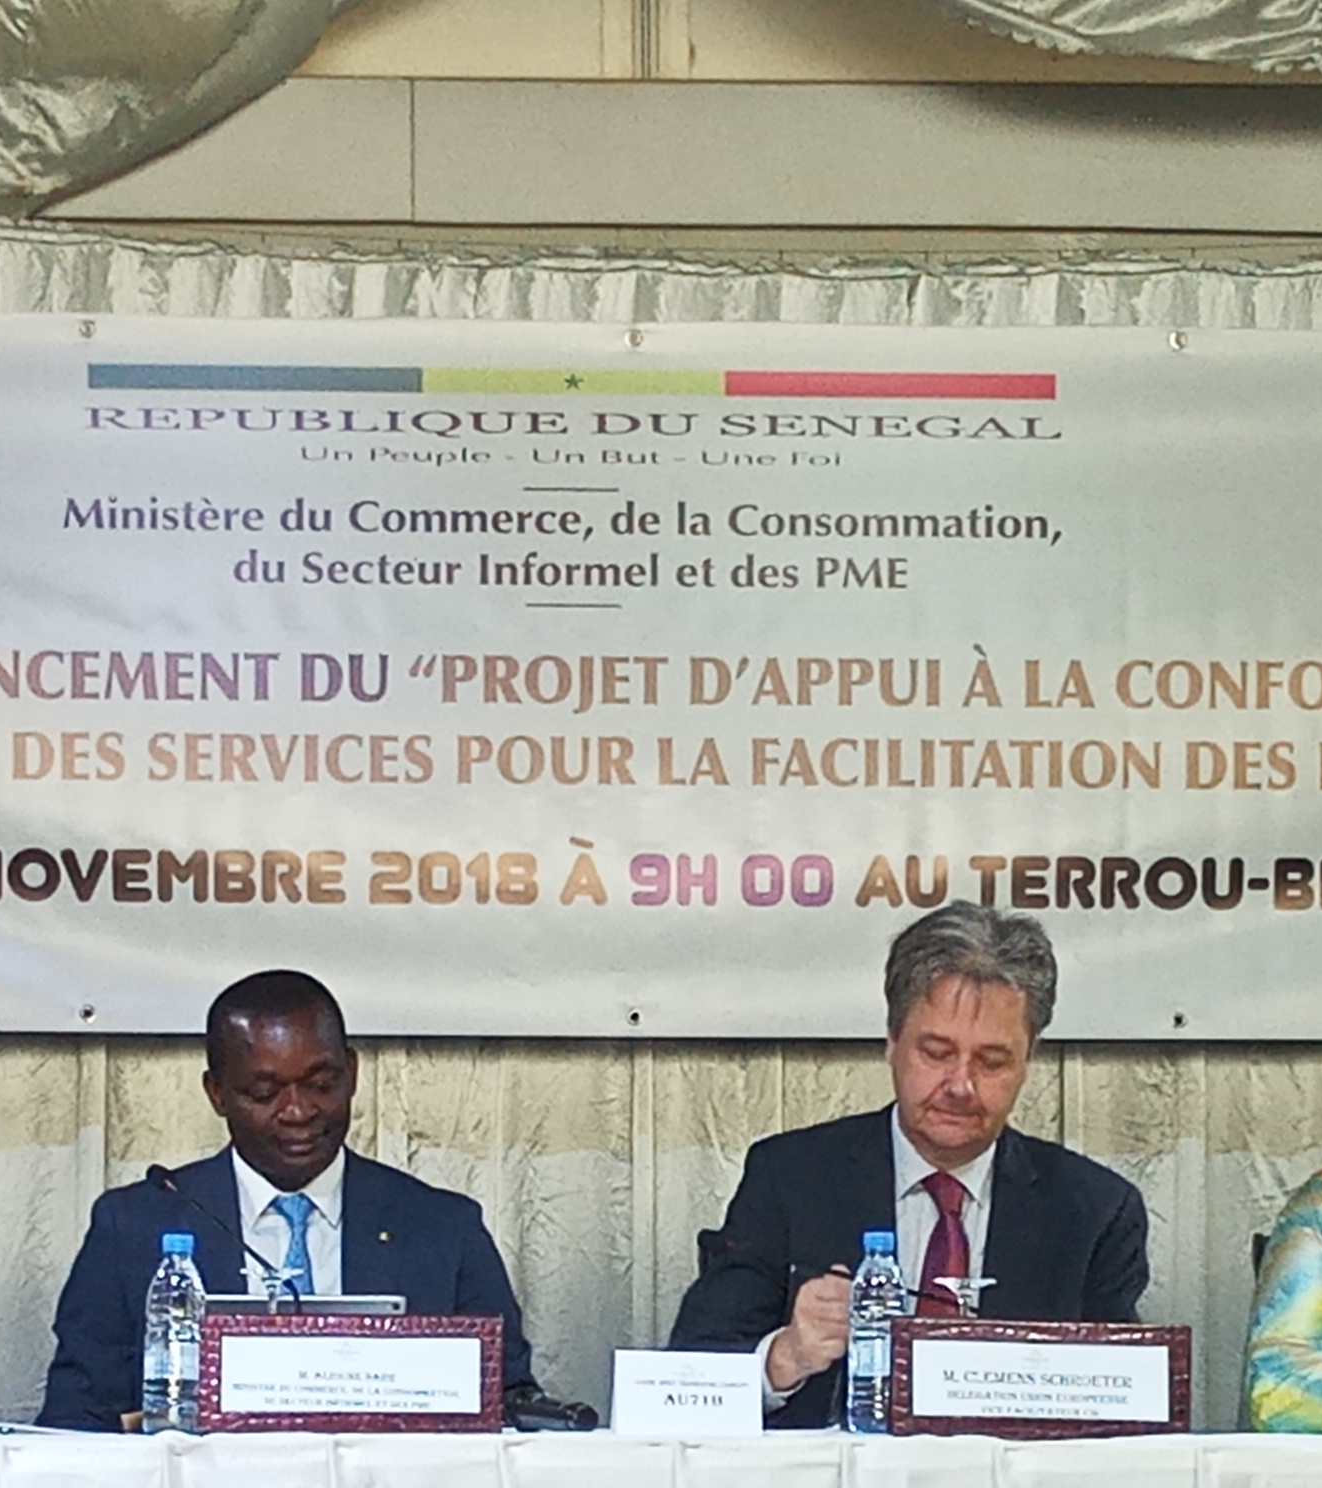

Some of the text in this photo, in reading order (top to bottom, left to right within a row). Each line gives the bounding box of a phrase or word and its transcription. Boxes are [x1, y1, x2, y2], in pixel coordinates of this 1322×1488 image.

[84, 408, 1062, 440] REPUBLIQUE DU SENEGAL
[303, 449, 353, 461] Un
[372, 449, 491, 467] Peuple
[534, 450, 585, 464] Un
[603, 452, 657, 464] But
[703, 452, 777, 466] Une
[793, 454, 840, 466] Foi
[62, 497, 1062, 546] Ministère du Commerce, de la Consommation,
[235, 550, 908, 589] du Secteur Informel et des PME
[303, 655, 389, 703] DU
[964, 645, 1003, 708] À
[1026, 661, 1096, 709] LA
[14, 733, 125, 781] DES
[150, 734, 434, 784] SERVICES
[459, 736, 636, 785] POUR
[658, 738, 730, 786] LA
[753, 739, 1162, 790] FACILITATION
[1187, 742, 1297, 791] DES
[370, 852, 539, 906] 2018
[561, 837, 609, 907] À
[631, 855, 718, 907] 9H
[743, 856, 834, 908] 00
[857, 856, 949, 908] AU
